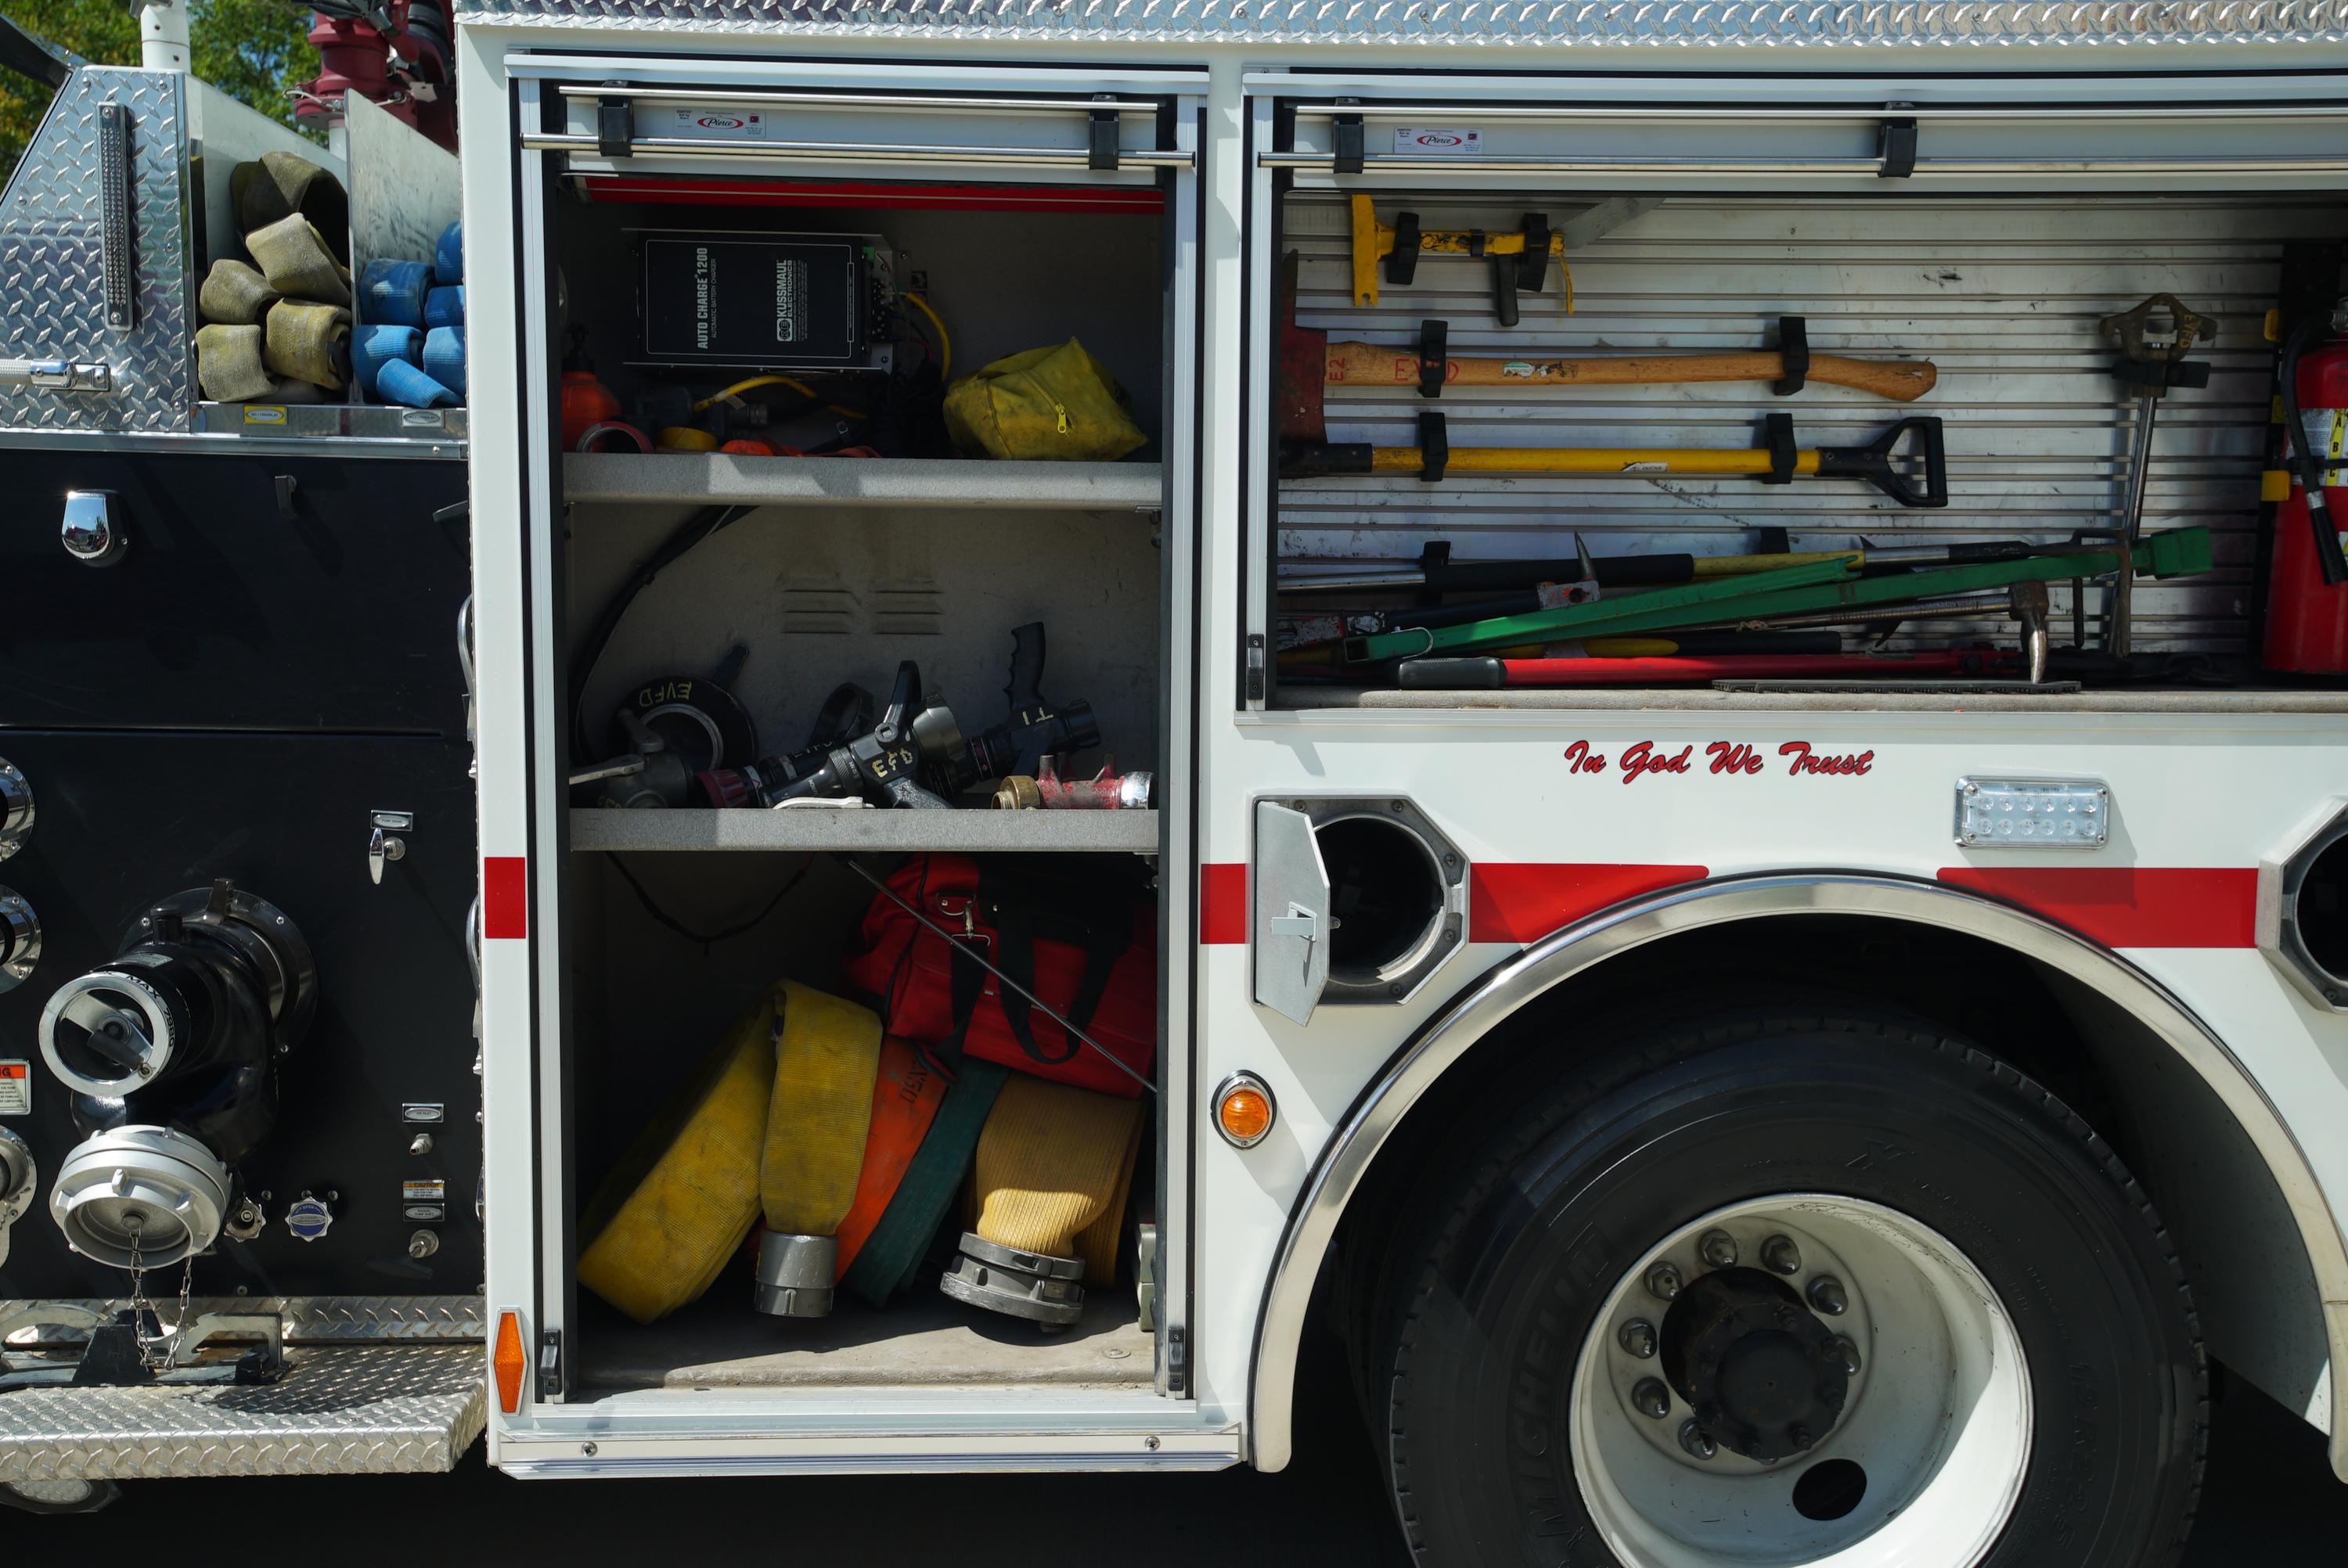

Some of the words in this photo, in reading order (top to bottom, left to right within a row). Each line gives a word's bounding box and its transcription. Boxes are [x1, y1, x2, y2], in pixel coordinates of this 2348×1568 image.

[708, 117, 733, 127] Pierce
[1427, 136, 1452, 145] Pierce
[697, 247, 708, 275] 1200
[776, 260, 787, 318] KUSSMAUL
[697, 322, 708, 349] AUTO
[1328, 358, 1345, 382] E2
[2335, 416, 2342, 428] A
[2332, 442, 2339, 453] B
[639, 681, 693, 707] EVFD
[1565, 740, 1607, 775] In
[1620, 740, 1693, 785] God
[1706, 741, 1764, 775] We
[1778, 741, 1875, 776] Trust
[126, 975, 160, 999] MAX
[164, 1007, 176, 1048] 7980
[1514, 1233, 1609, 1537] MICHELIN
